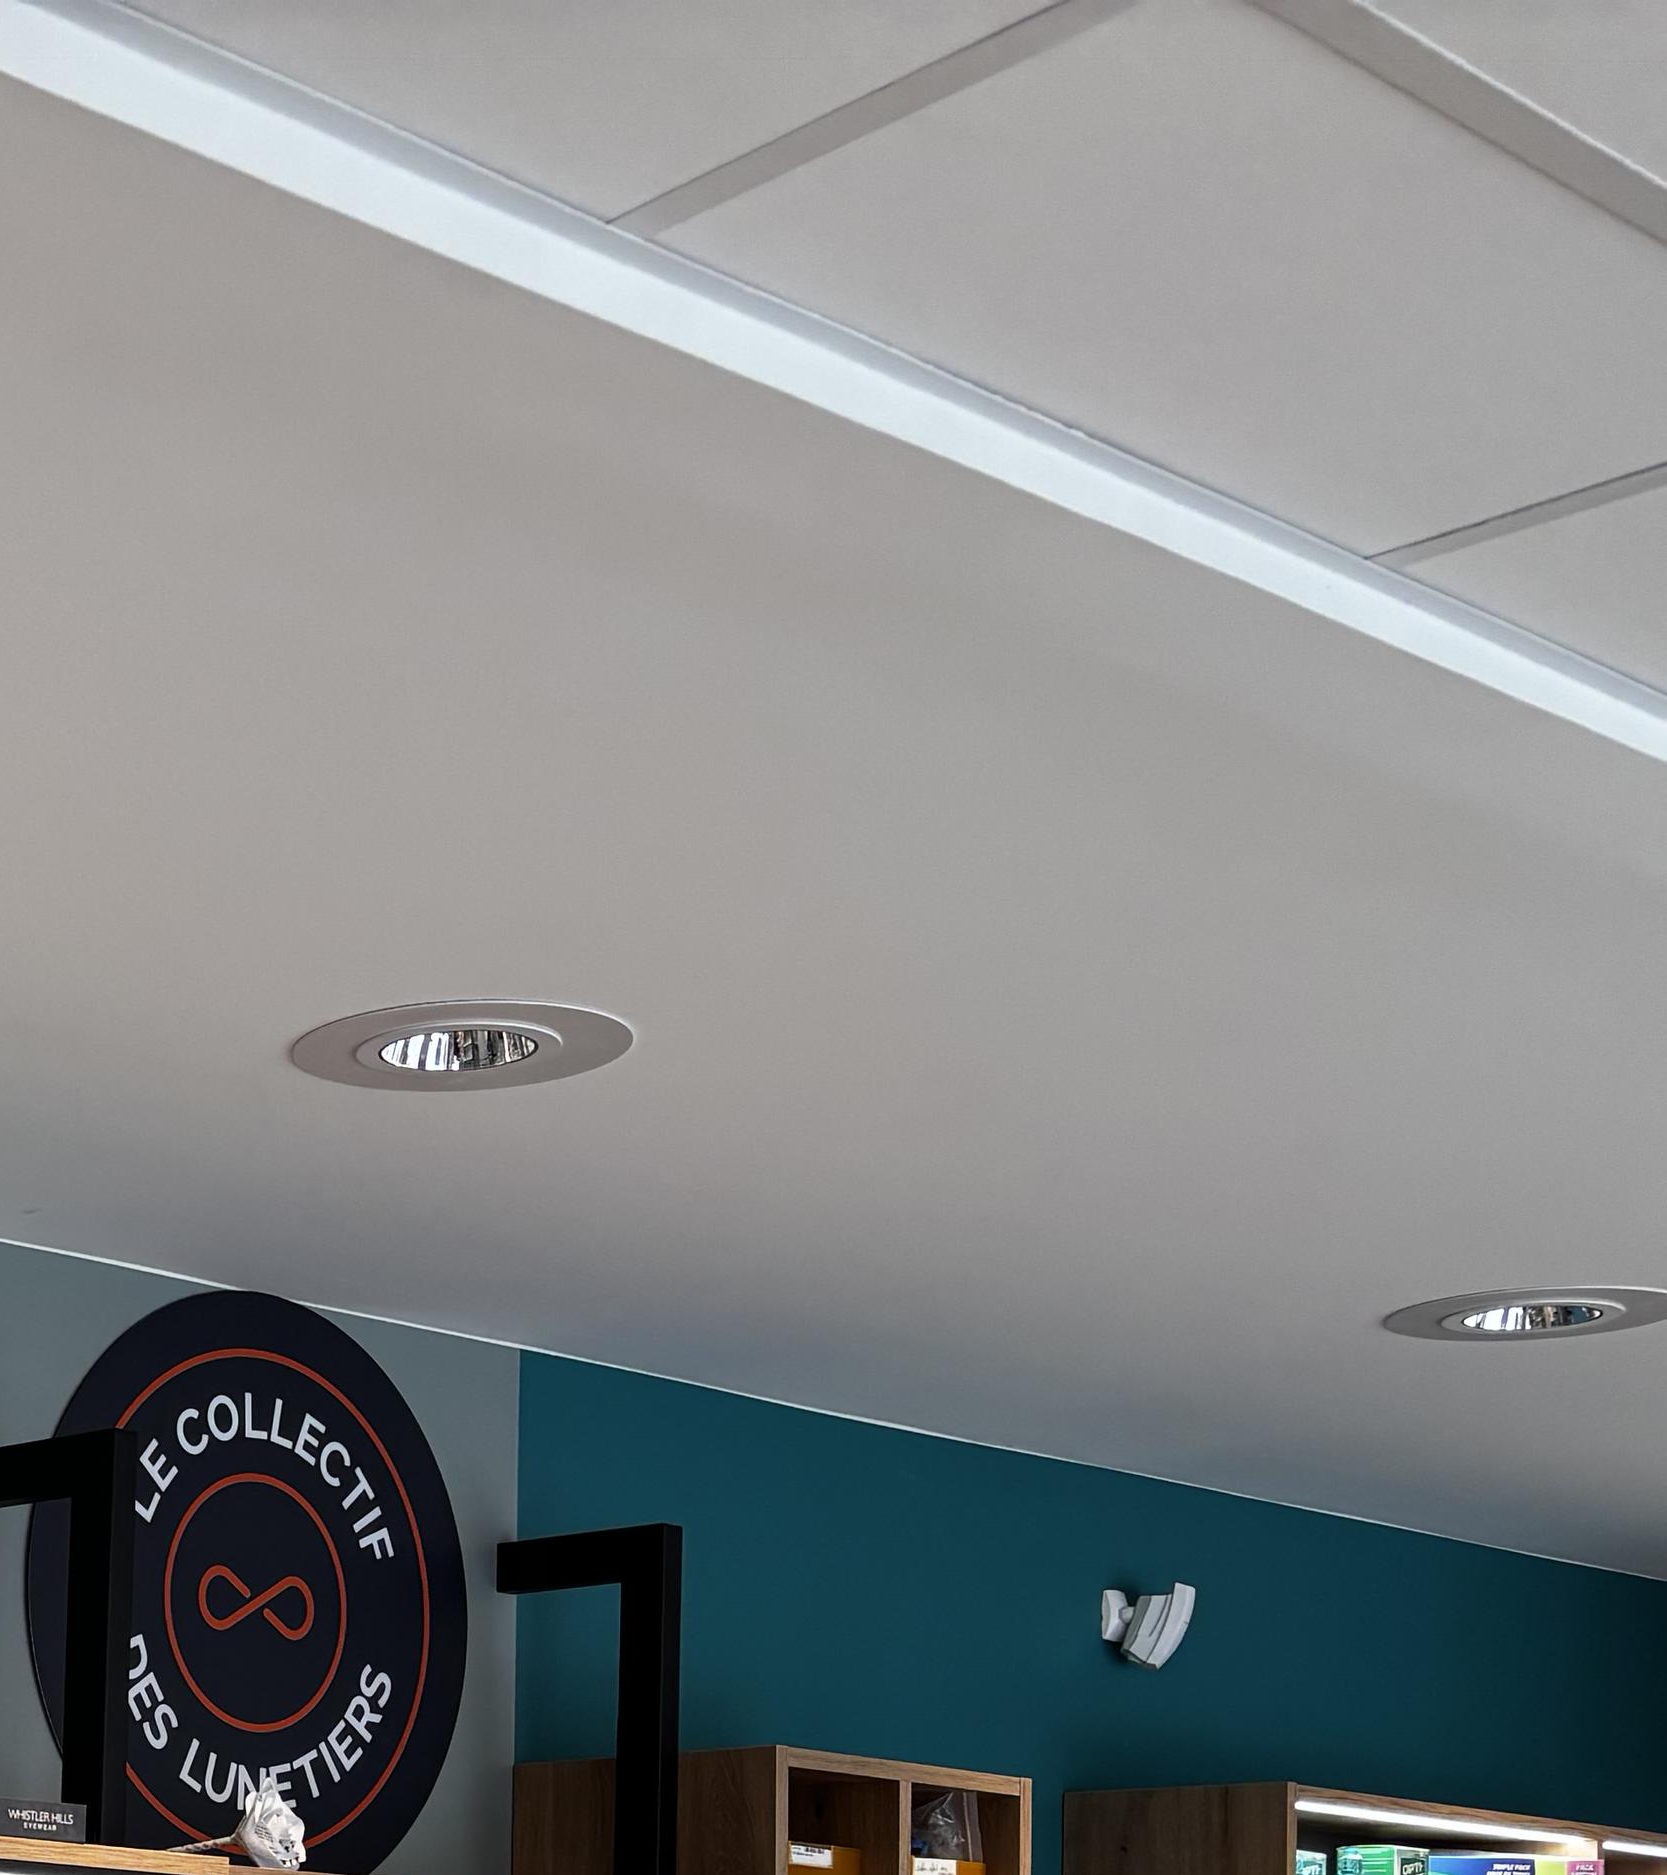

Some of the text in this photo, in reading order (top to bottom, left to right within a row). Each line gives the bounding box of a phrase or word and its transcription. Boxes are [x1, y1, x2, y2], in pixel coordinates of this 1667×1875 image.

[134, 1392, 394, 1560] LE COLLECTIF
[128, 1633, 393, 1811] DES LUNETIERS
[8, 1808, 74, 1825] WHISTLER HILLS
[23, 1823, 57, 1831] EYEWEAR
